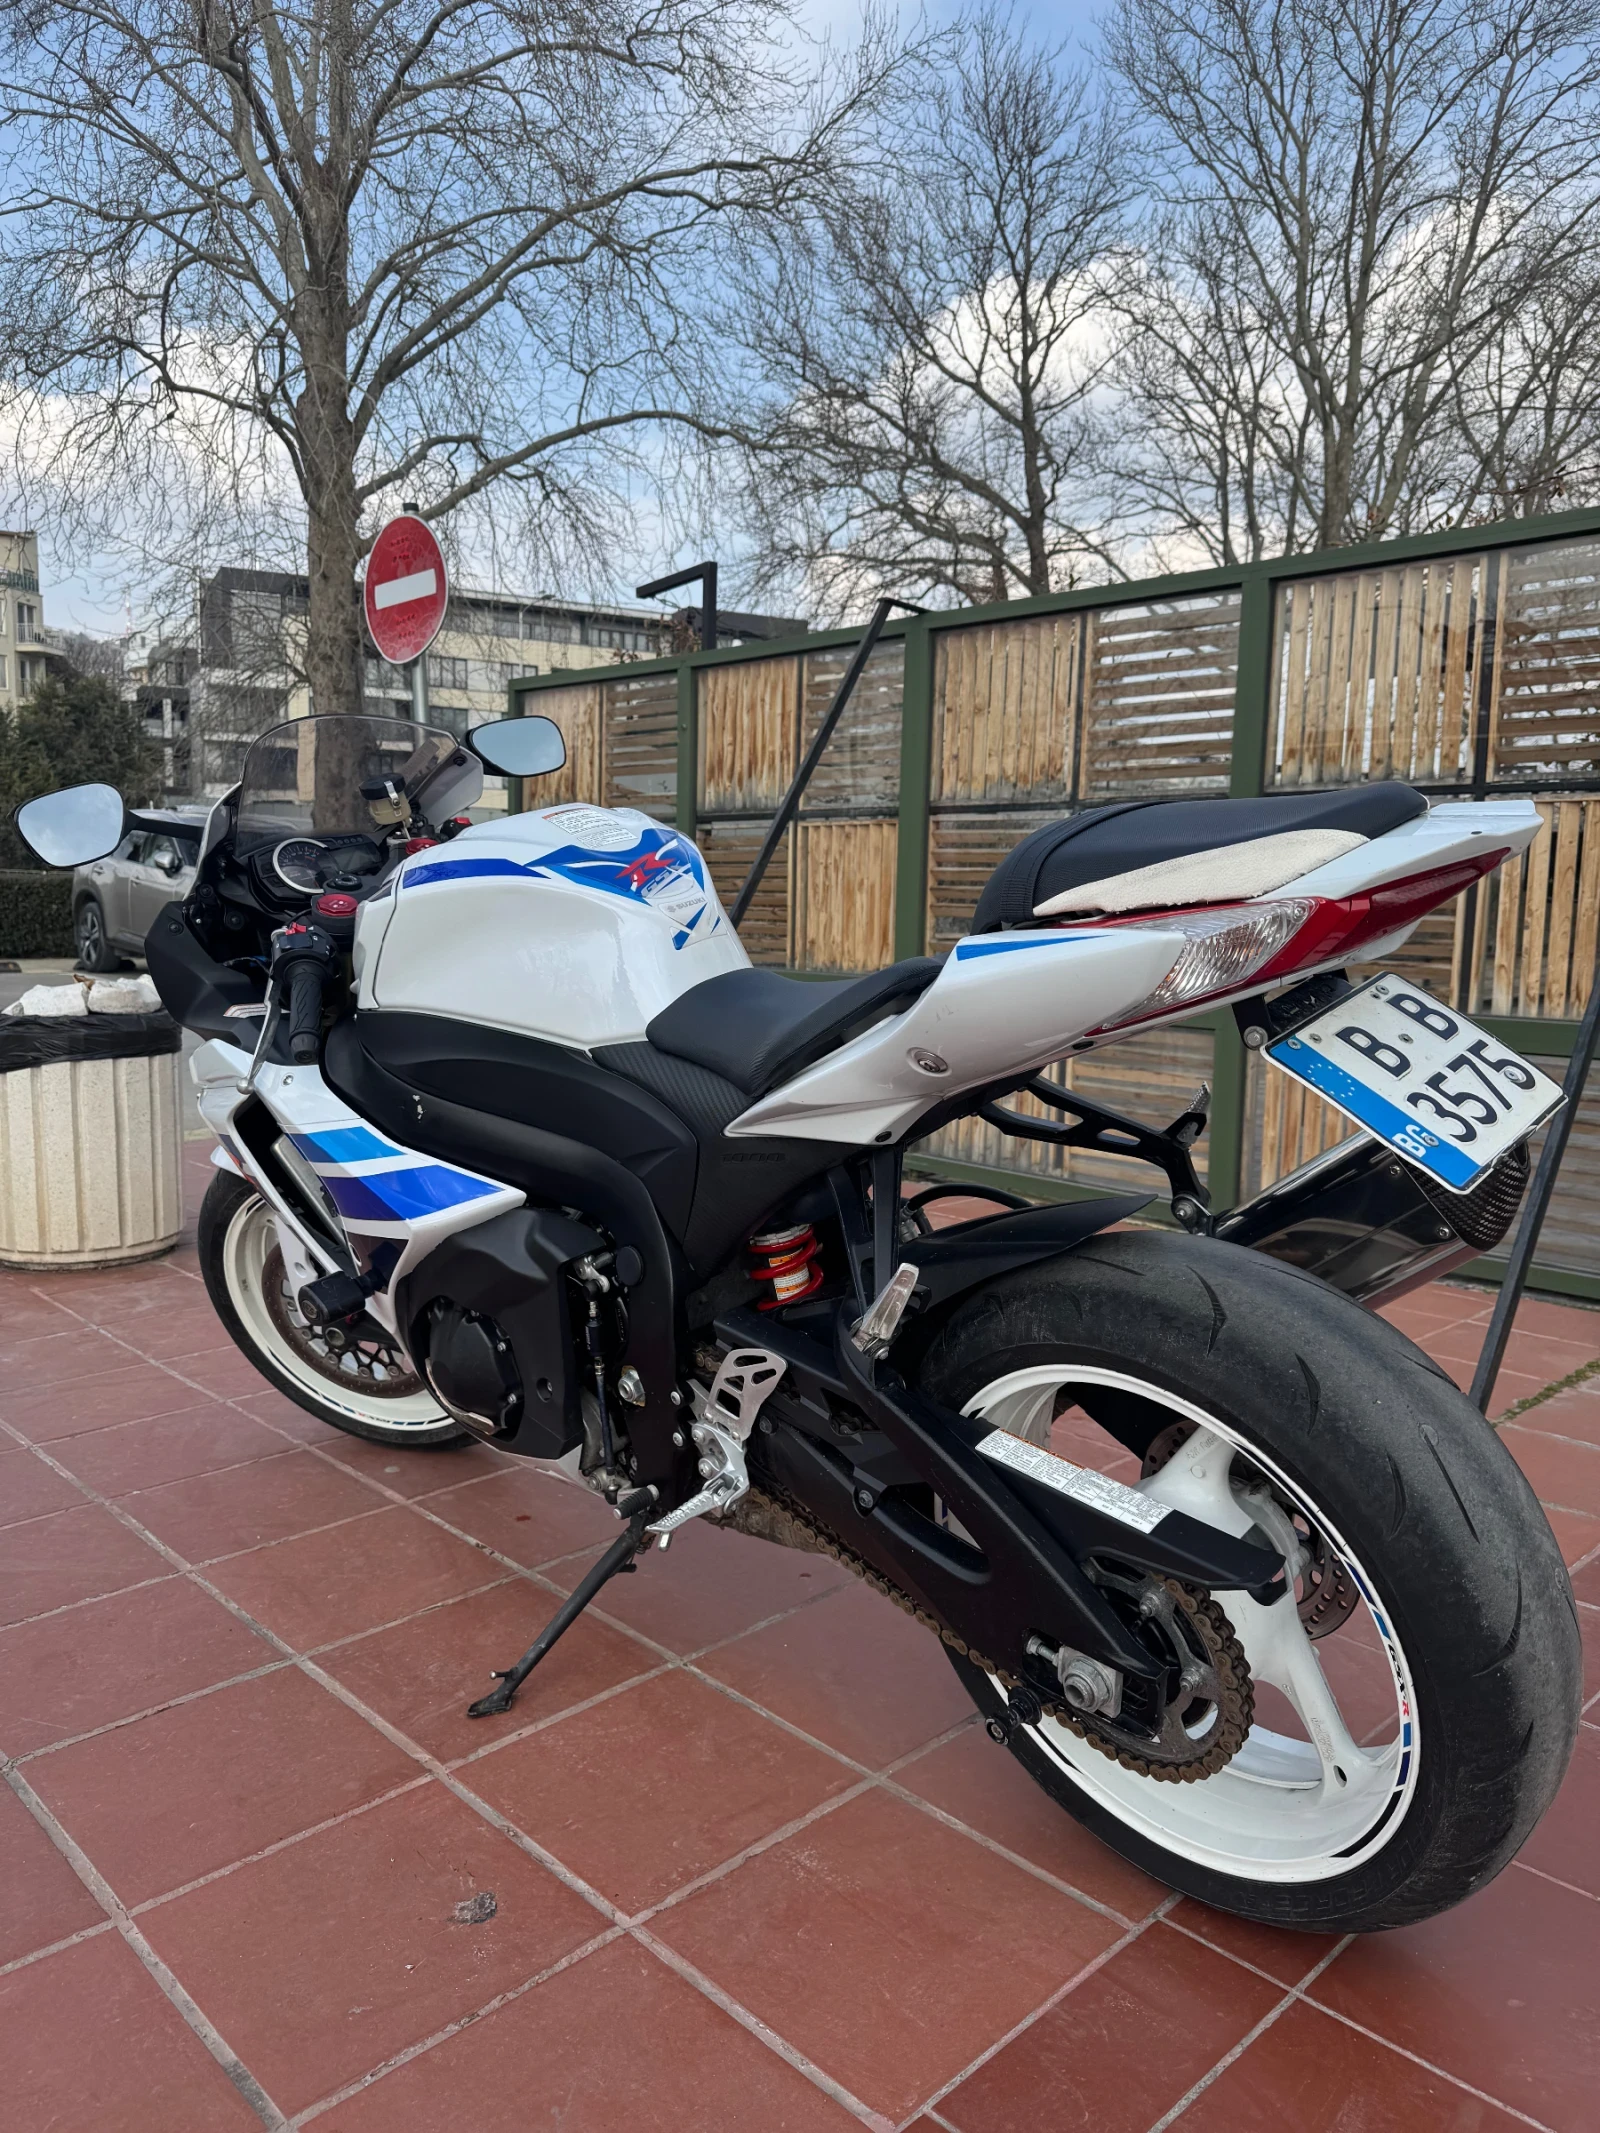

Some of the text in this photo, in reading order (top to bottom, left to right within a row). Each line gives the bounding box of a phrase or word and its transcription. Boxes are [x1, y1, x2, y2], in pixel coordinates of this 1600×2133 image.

[676, 896, 706, 910] SUZUKI
[1335, 1026, 1413, 1079] B
[1386, 993, 1460, 1041] B
[1406, 1039, 1537, 1143] 3575
[1392, 1124, 1436, 1158] BG
